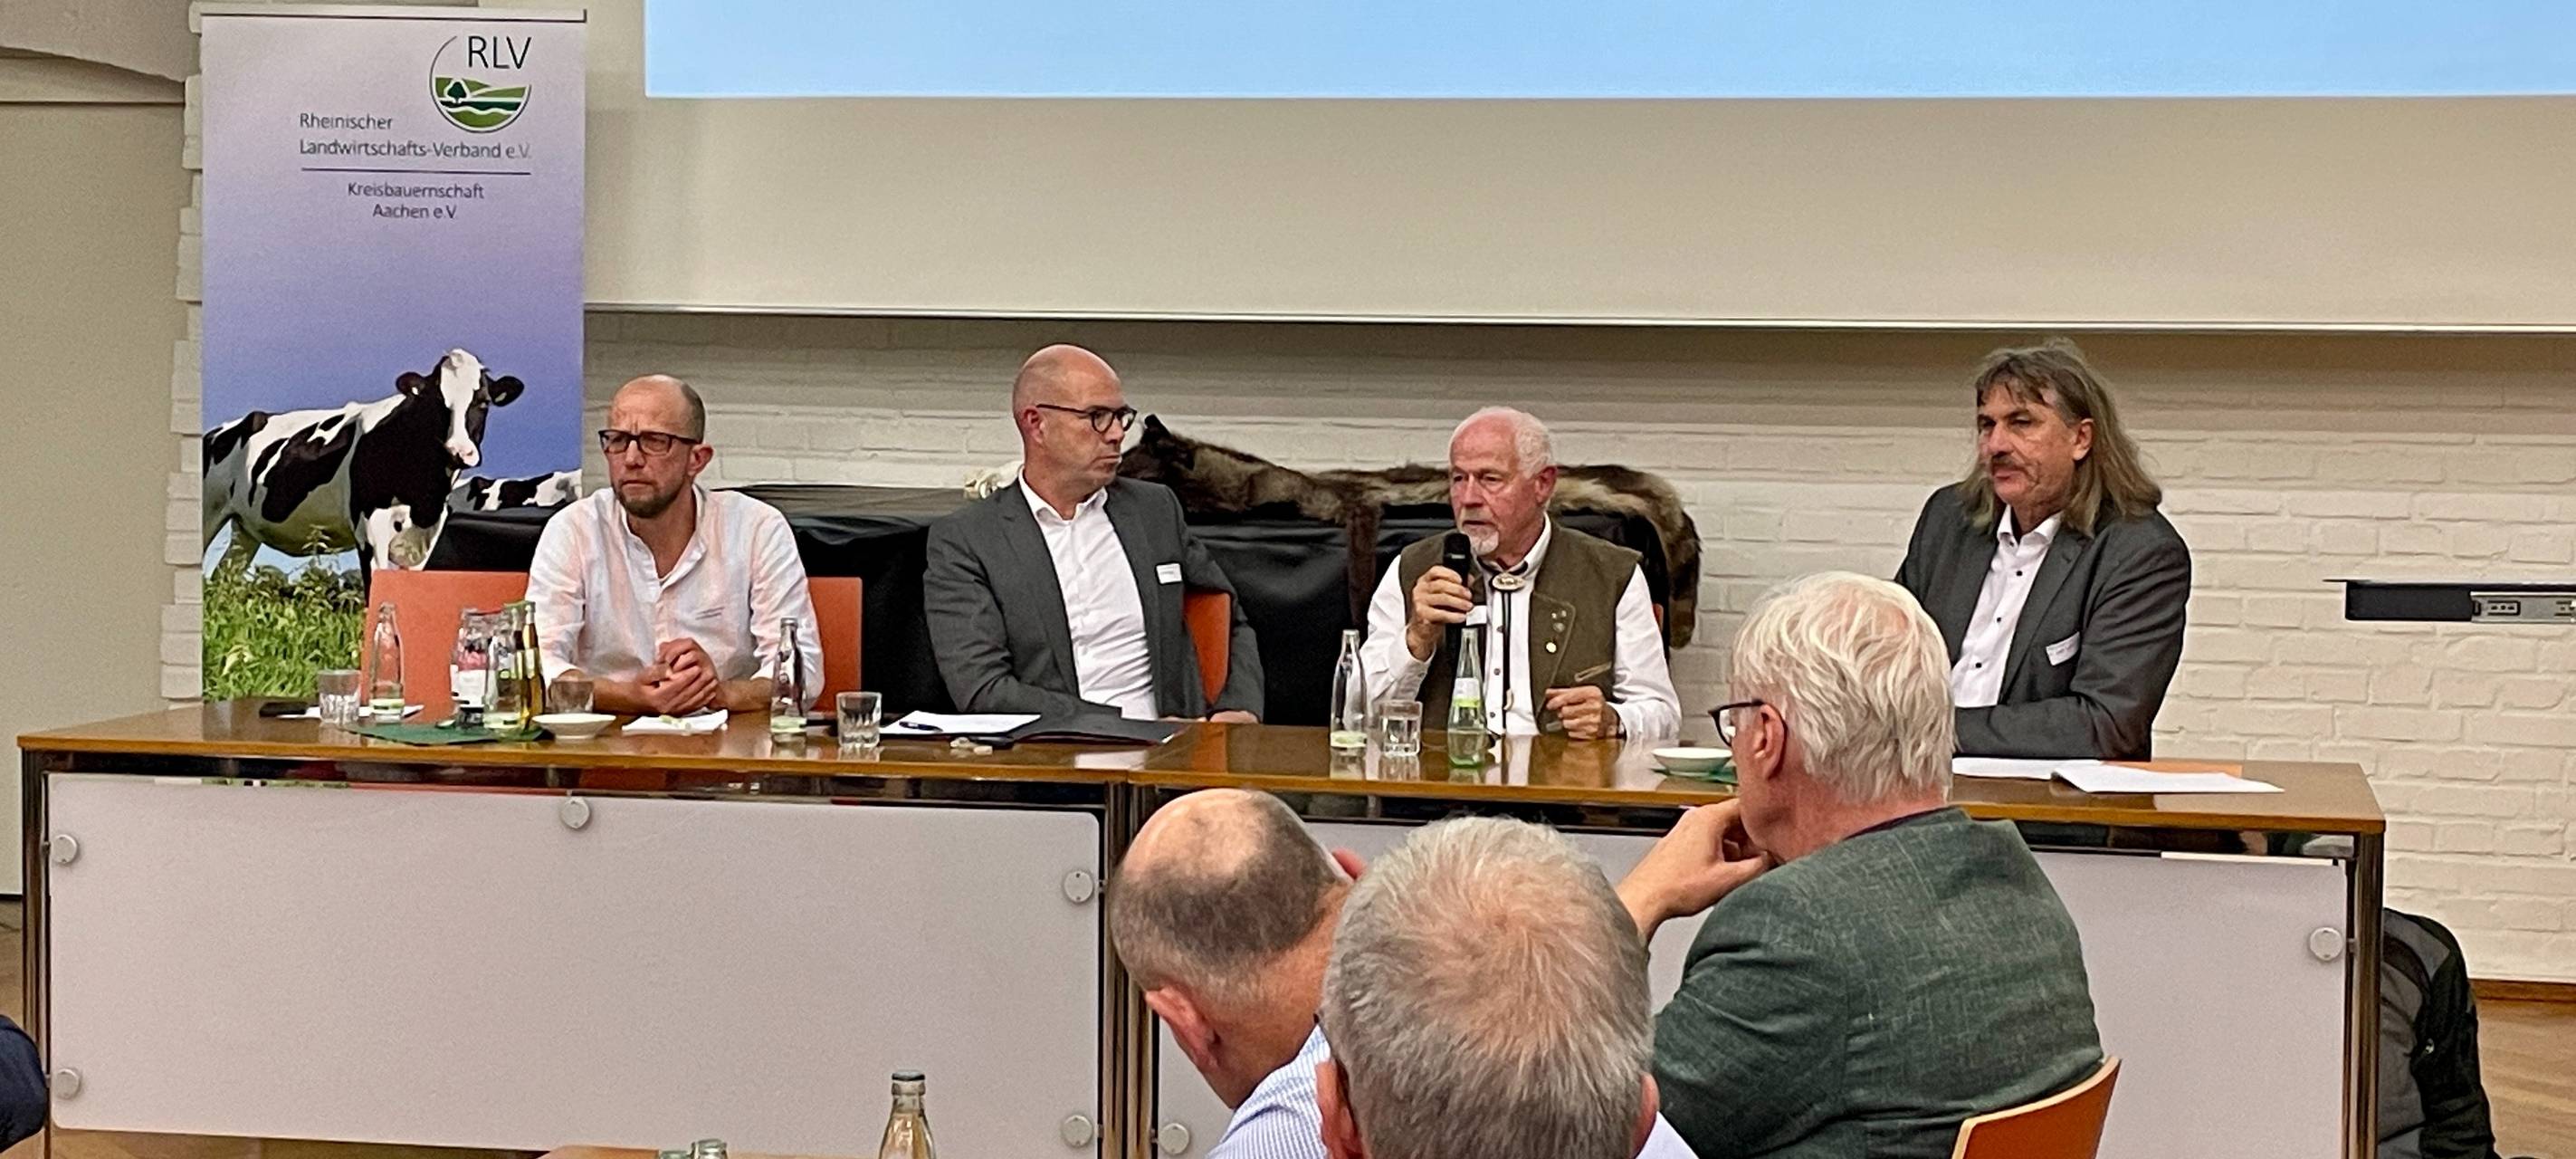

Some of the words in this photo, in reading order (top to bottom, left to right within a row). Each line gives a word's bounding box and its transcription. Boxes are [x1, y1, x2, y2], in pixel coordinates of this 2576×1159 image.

[467, 35, 532, 70] RLV
[299, 113, 393, 130] Rheinischer
[299, 139, 501, 159] Landwirtschafts-Verband
[348, 182, 485, 199] Kreisbauernschaft
[372, 204, 430, 219] Aachen
